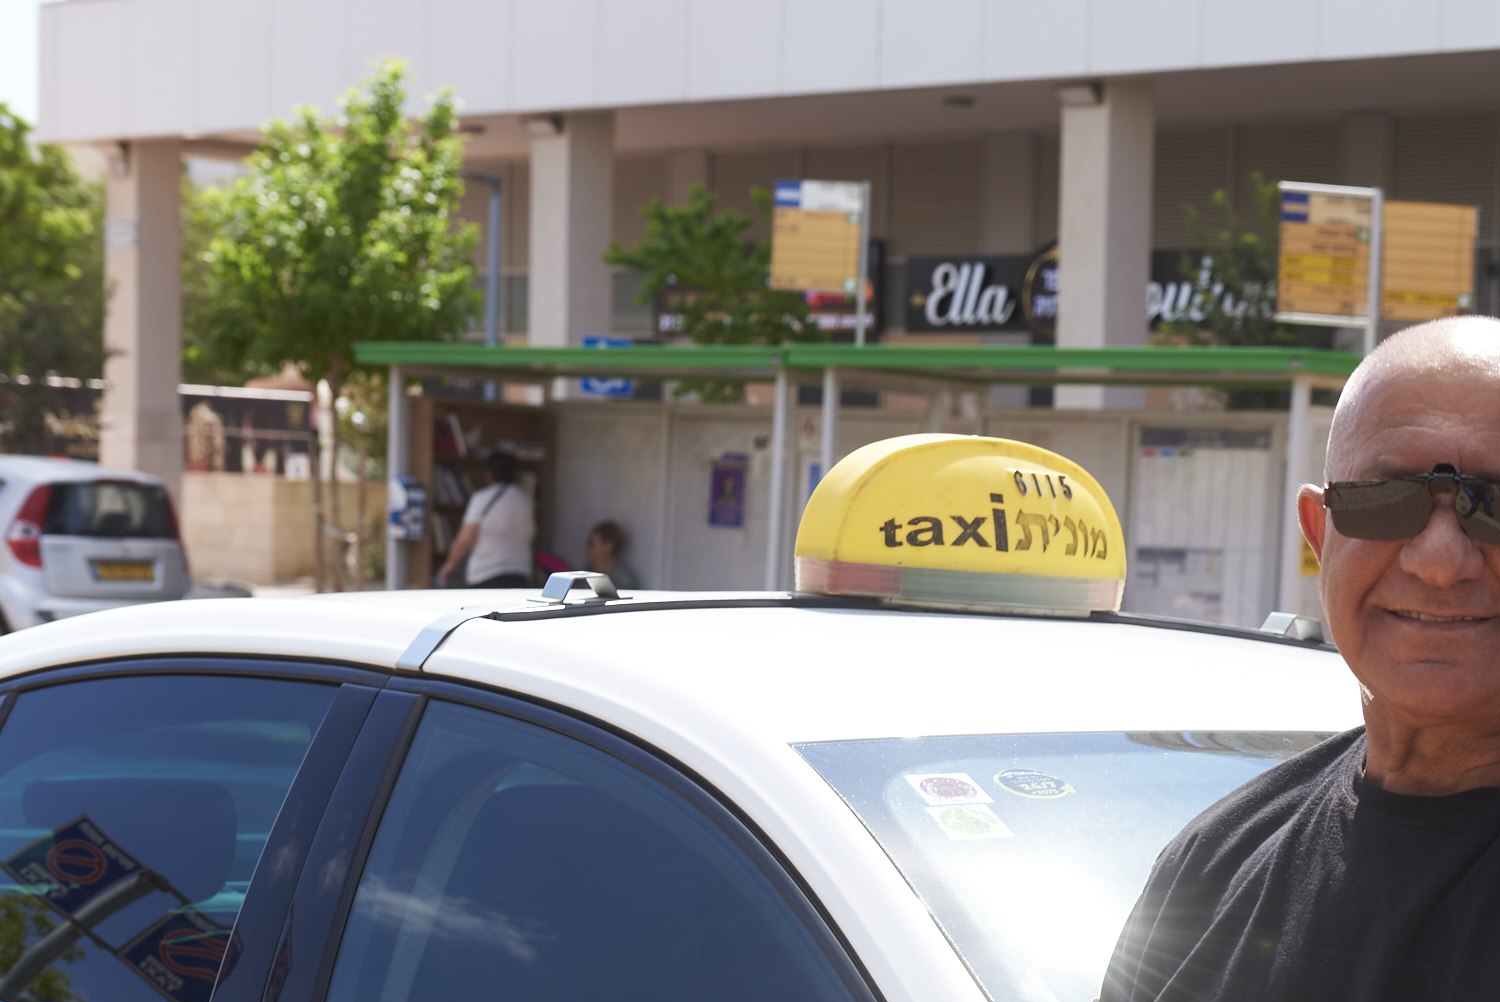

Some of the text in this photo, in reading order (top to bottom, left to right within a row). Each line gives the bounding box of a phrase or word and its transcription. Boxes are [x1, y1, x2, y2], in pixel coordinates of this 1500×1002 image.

[925, 262, 1014, 326] Ella
[1013, 470, 1073, 501] 6115
[879, 492, 1009, 553] taxi
[1015, 508, 1108, 560] מונית
